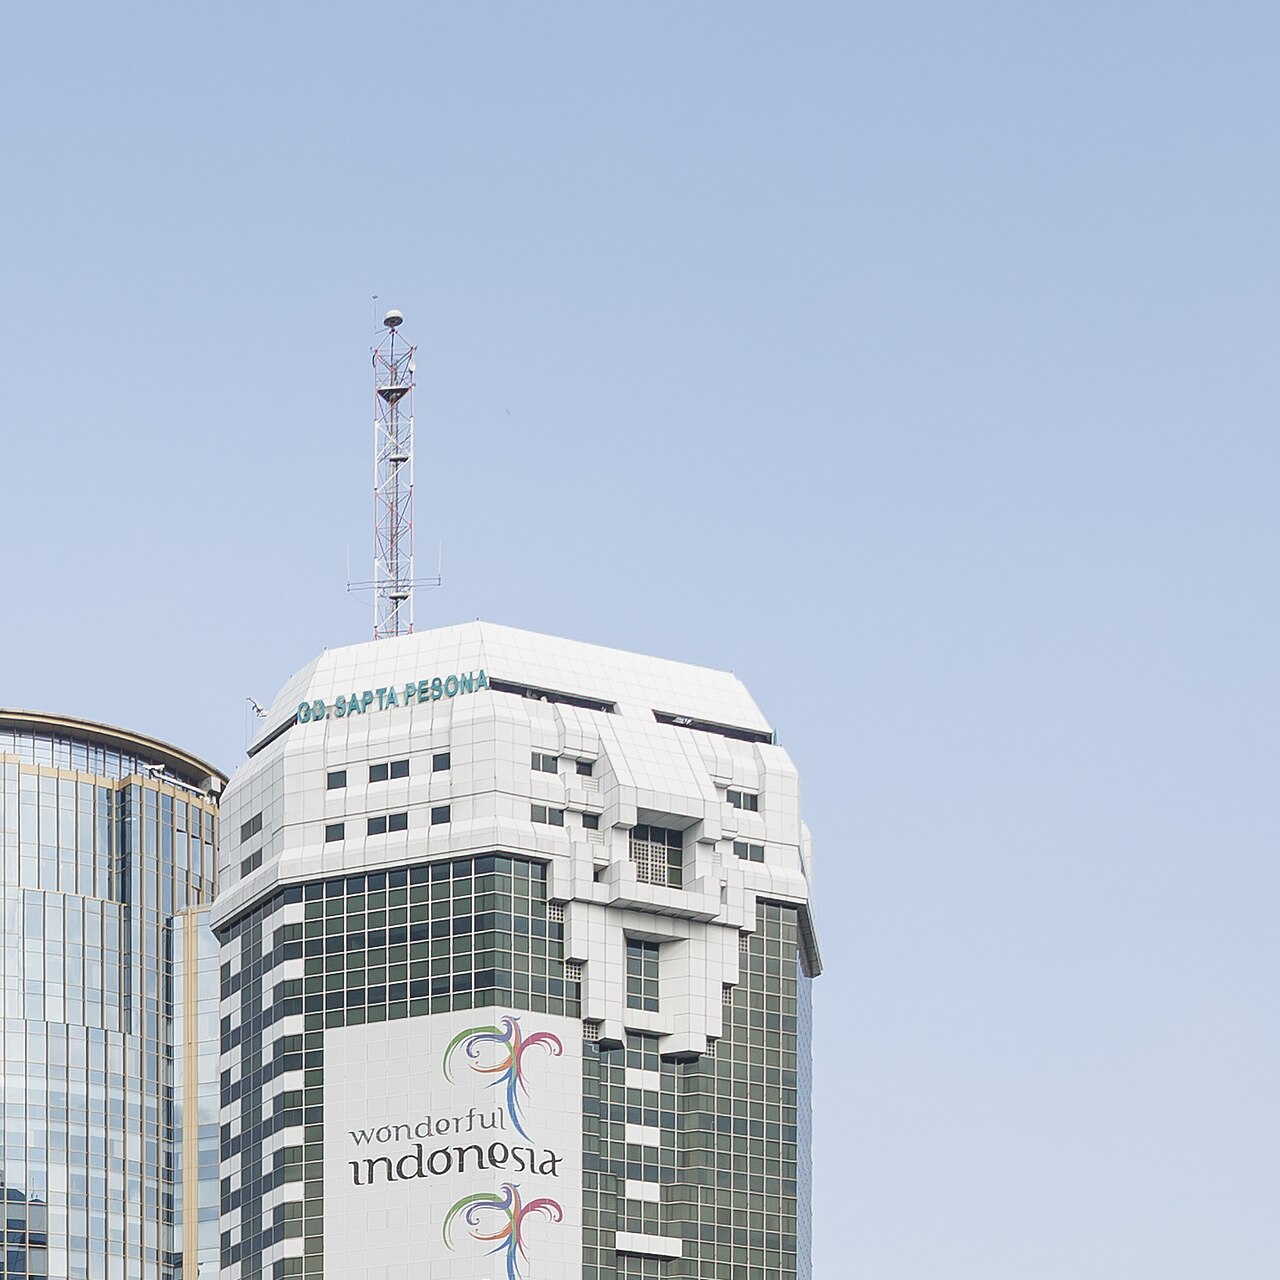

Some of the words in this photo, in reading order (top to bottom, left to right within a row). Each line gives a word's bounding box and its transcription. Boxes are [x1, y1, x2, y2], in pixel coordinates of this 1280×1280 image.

[296, 699, 330, 725] GD.
[334, 685, 400, 718] SAPTA
[404, 669, 491, 706] PESONA
[348, 1107, 507, 1146] wonderful
[348, 1142, 564, 1186] indonesia
